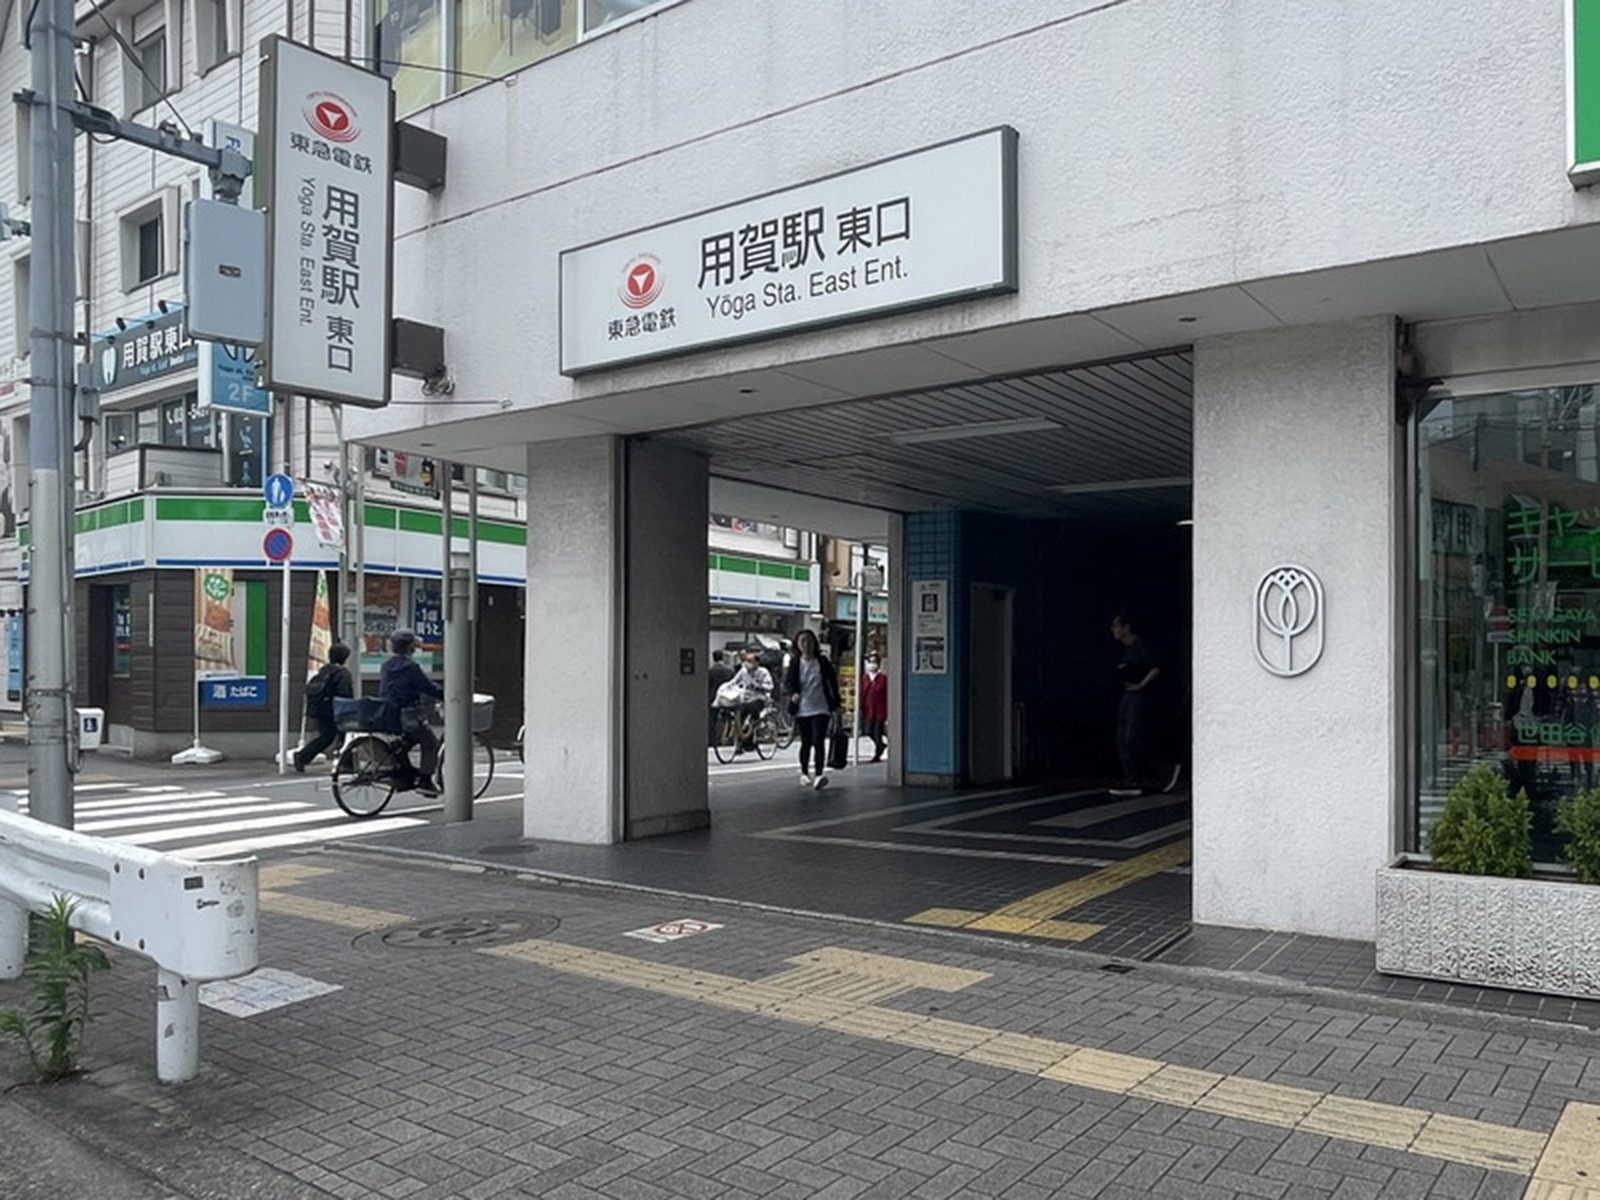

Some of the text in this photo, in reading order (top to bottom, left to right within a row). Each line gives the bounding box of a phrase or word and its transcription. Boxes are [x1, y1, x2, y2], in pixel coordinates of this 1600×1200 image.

[290, 132, 372, 174] 東急電鉄
[698, 196, 911, 290] 用賀駅 東口
[299, 255, 315, 292] East
[321, 184, 360, 373] 用賀駅 東口
[706, 254, 909, 321] Yōga Sta. East Ent.
[299, 295, 315, 327] Ent.
[607, 306, 677, 341] 東急電鉄
[1507, 546, 1600, 583] サー
[1507, 629, 1581, 644] SHINKIN
[1507, 650, 1557, 665] BANK
